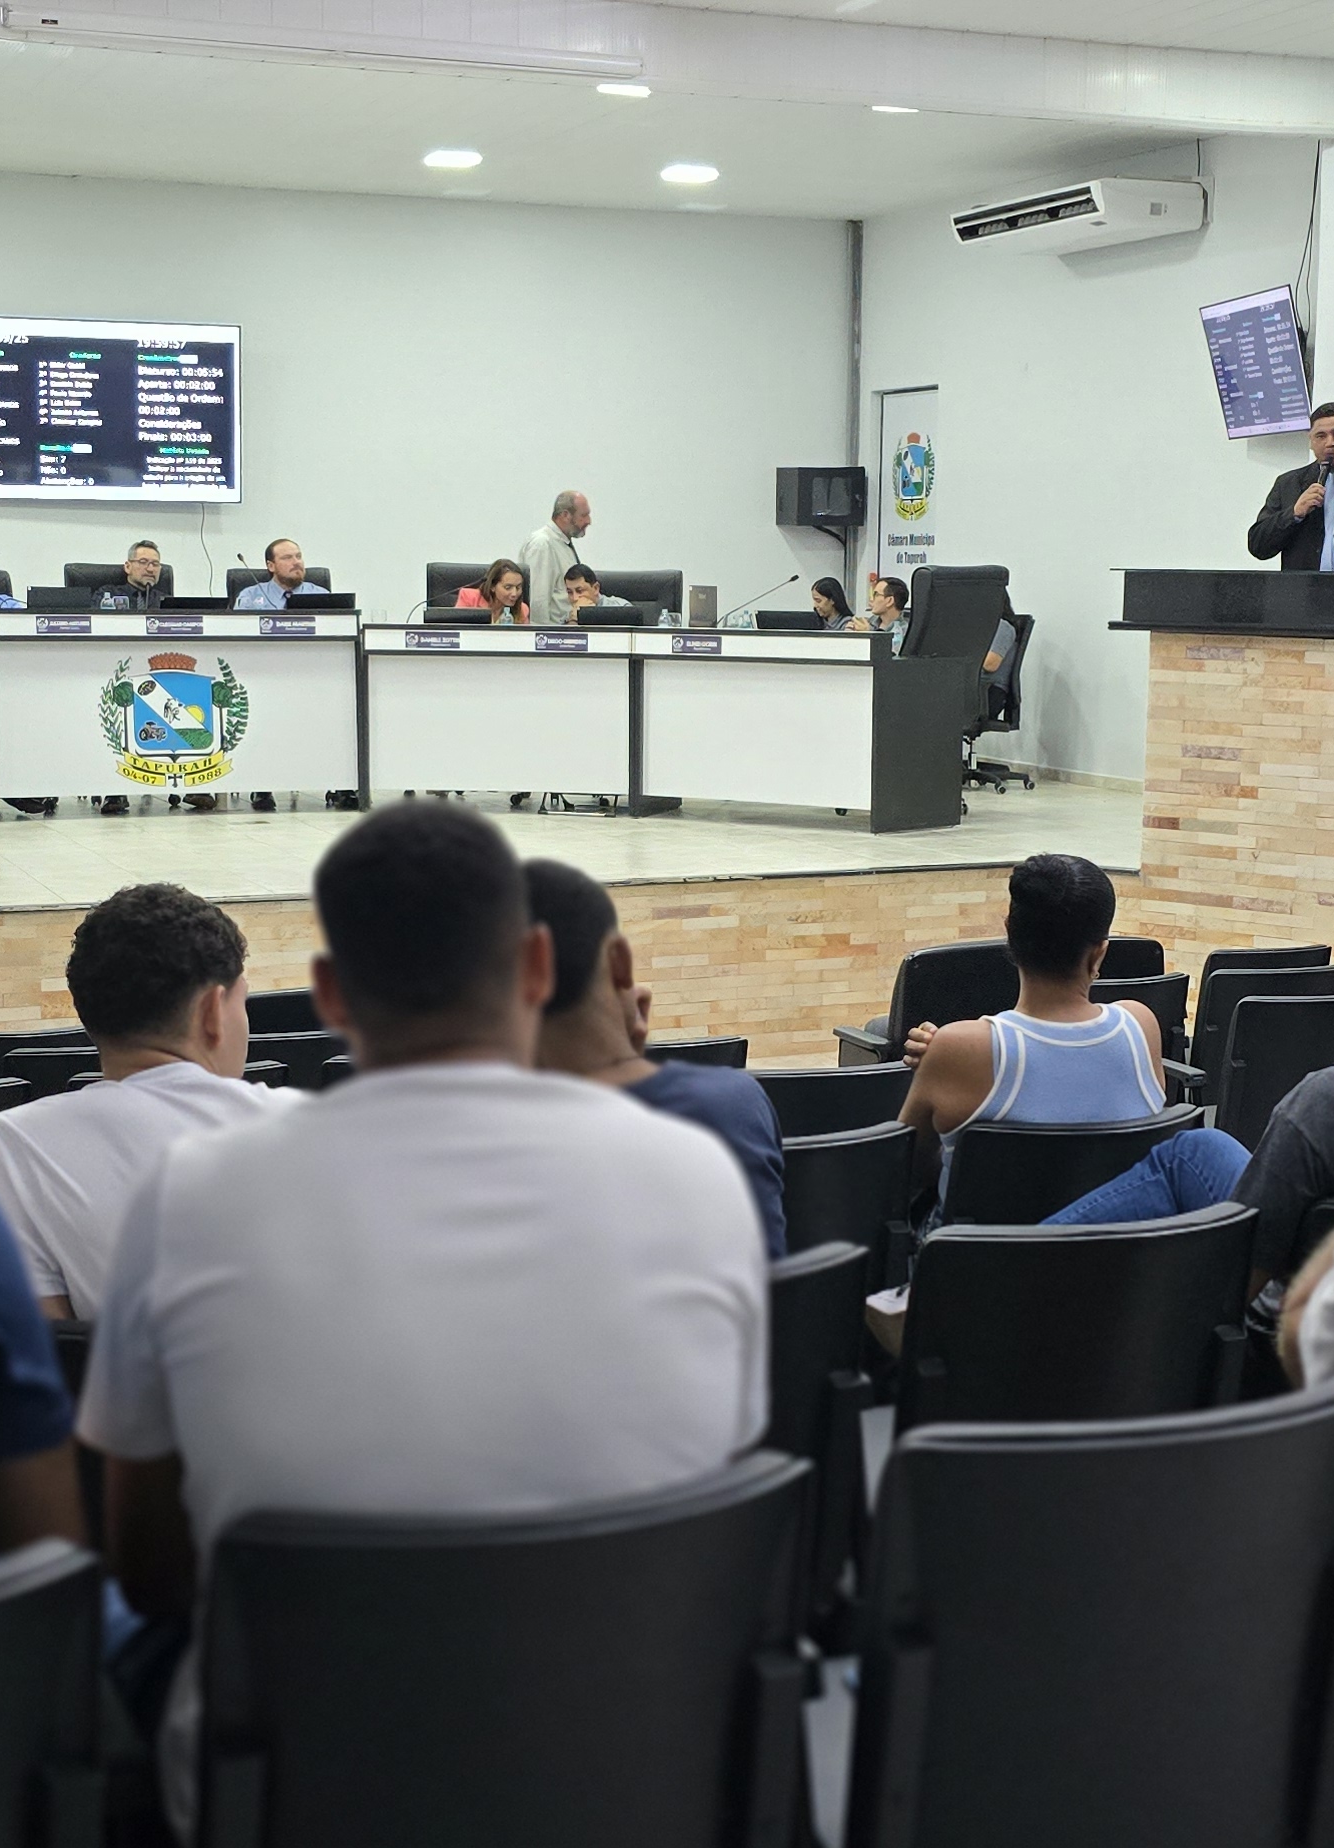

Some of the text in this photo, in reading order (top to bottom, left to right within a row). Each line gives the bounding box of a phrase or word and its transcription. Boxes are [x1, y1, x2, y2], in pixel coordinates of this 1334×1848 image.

[137, 339, 187, 350] 19:59:57
[137, 419, 202, 430] Considerações
[60, 455, 67, 464] 7
[887, 532, 935, 547] Câmara Municipa
[896, 551, 927, 565] de Tapurah
[130, 755, 213, 774] TAPURAH
[122, 767, 223, 785] 04-07 1988
